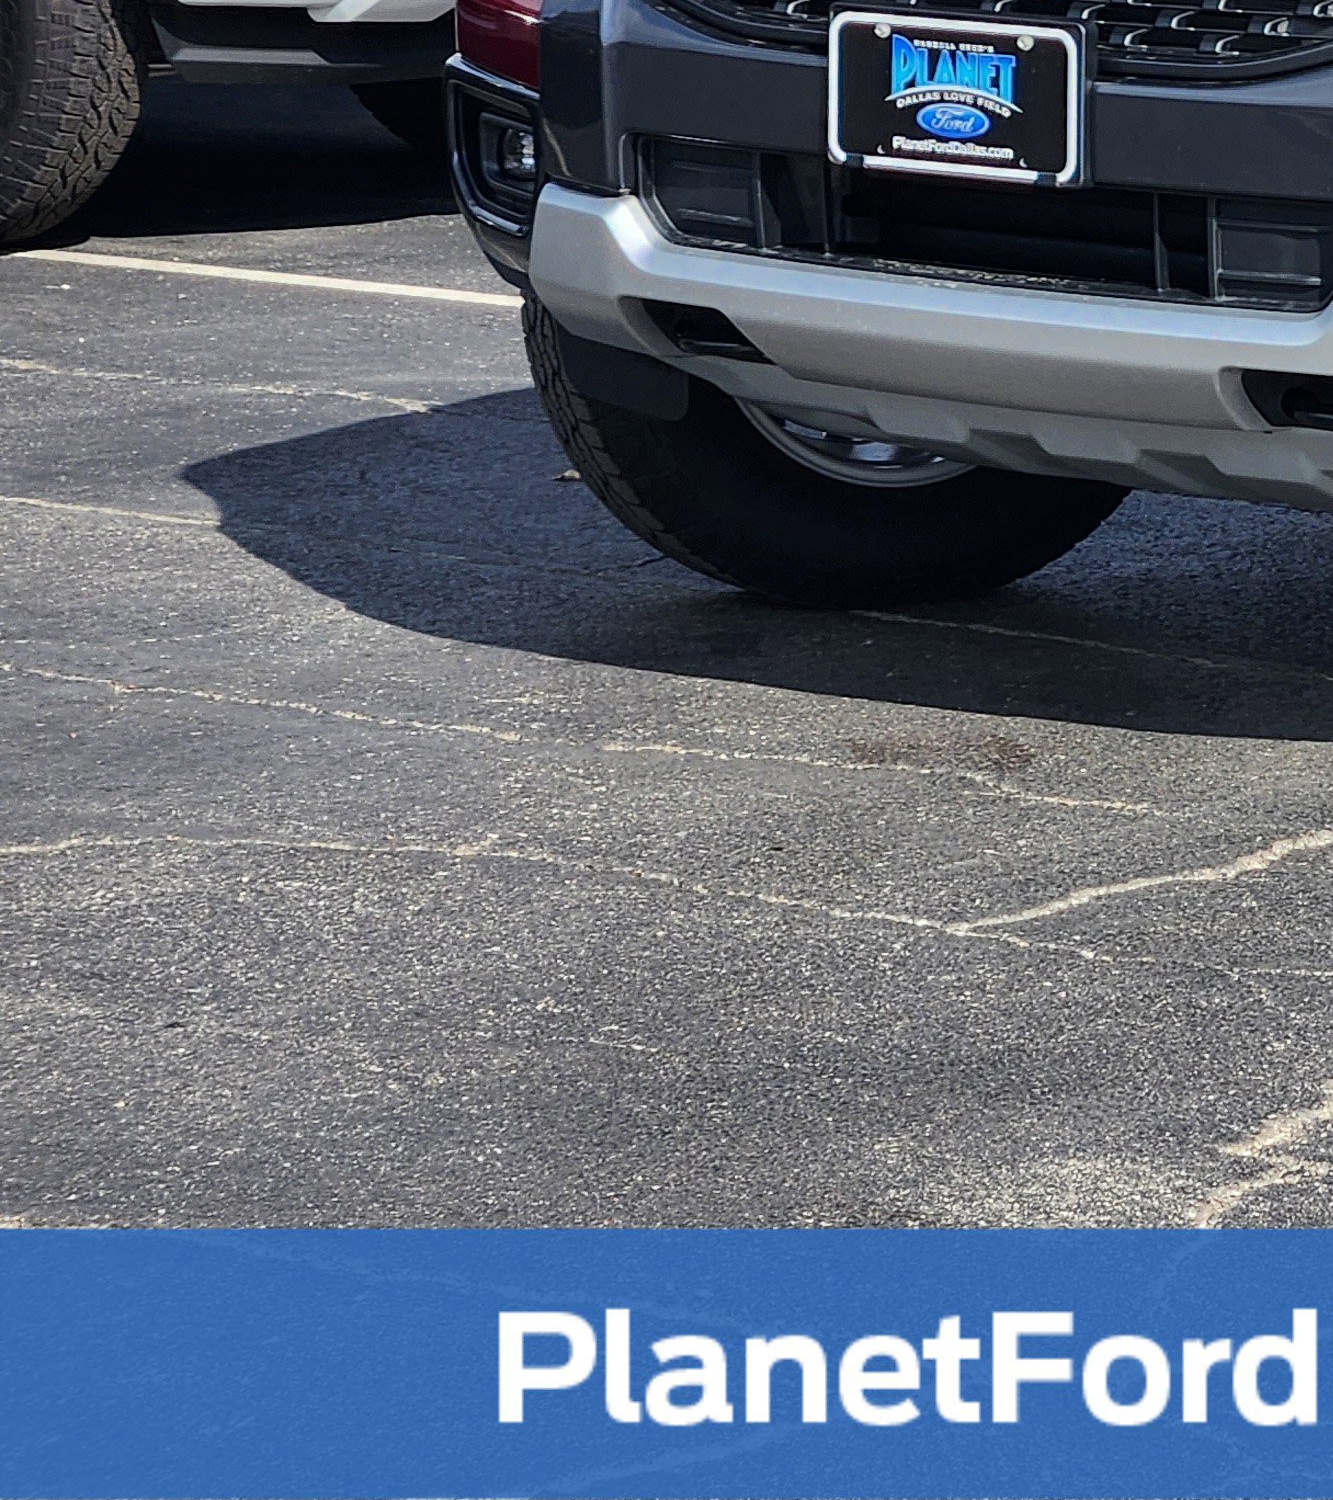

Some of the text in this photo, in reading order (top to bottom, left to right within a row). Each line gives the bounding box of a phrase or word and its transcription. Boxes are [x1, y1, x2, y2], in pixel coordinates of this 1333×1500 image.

[891, 33, 1016, 105] PLANET
[943, 92, 974, 105] LOVE
[931, 107, 975, 133] Ford
